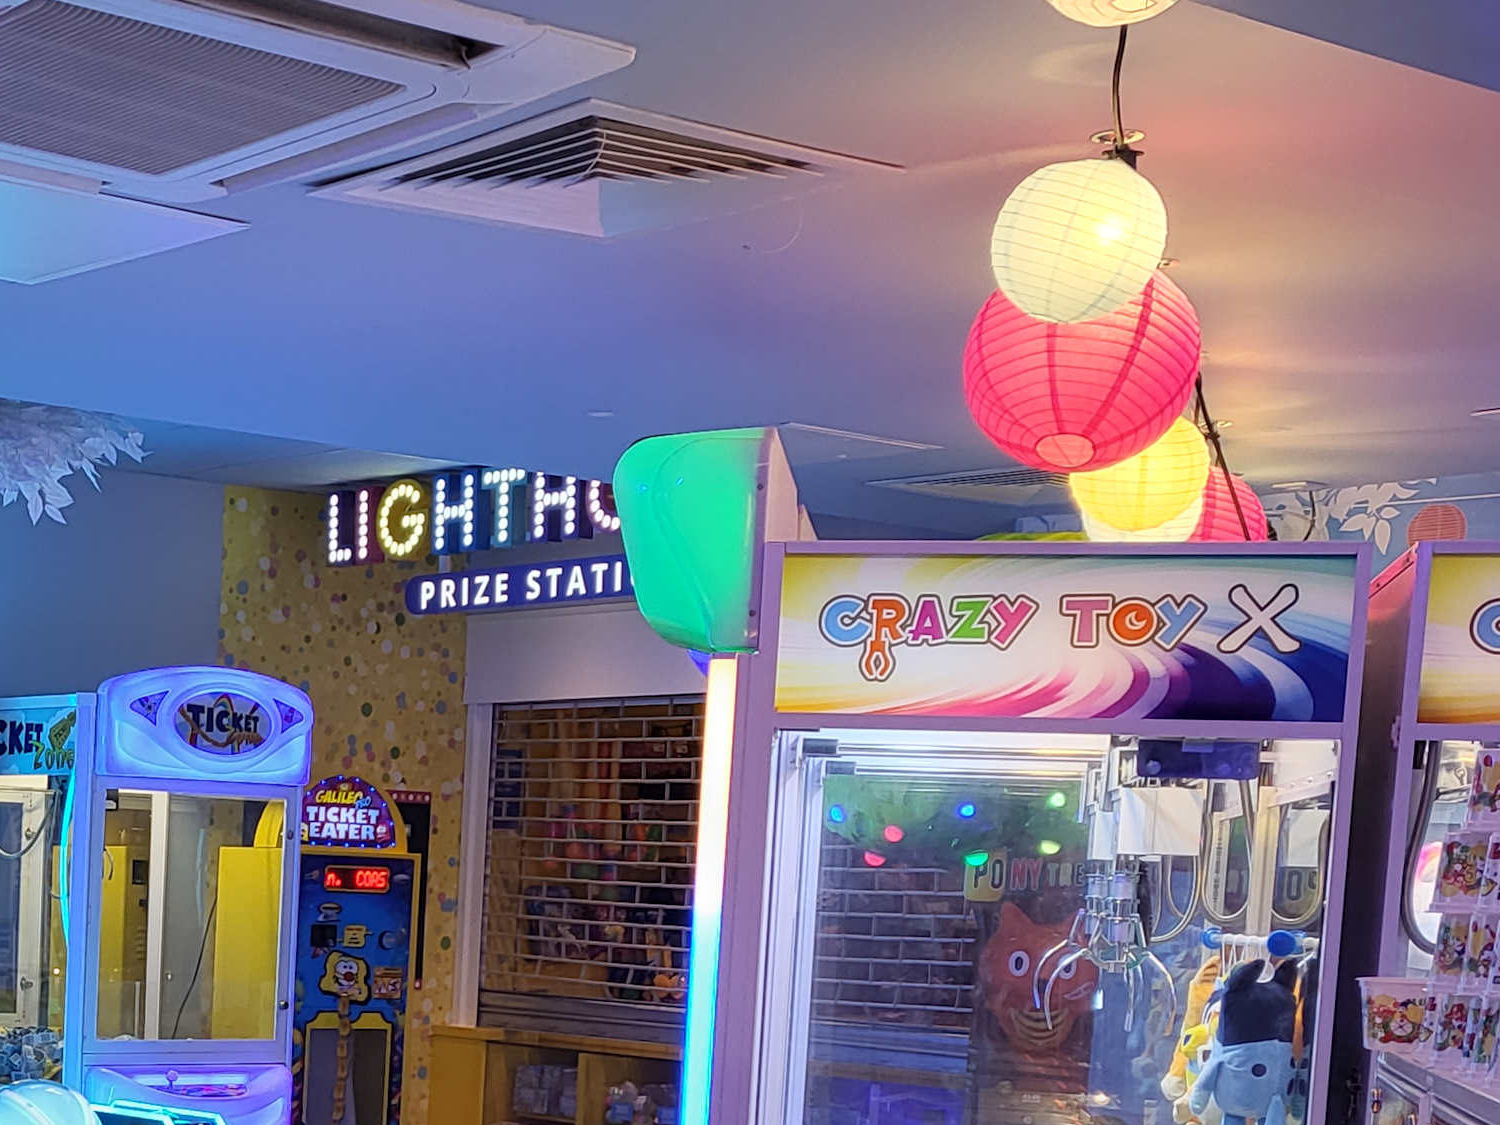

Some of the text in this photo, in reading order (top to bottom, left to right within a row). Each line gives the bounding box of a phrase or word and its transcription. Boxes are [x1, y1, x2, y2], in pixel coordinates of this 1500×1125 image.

[420, 561, 623, 611] PRIZE STATI
[819, 583, 1301, 670] CRAZY TOY X
[186, 703, 260, 733] TICKET
[306, 805, 380, 825] TICKET
[308, 821, 376, 841] EATER
[973, 856, 1044, 892] PONY
